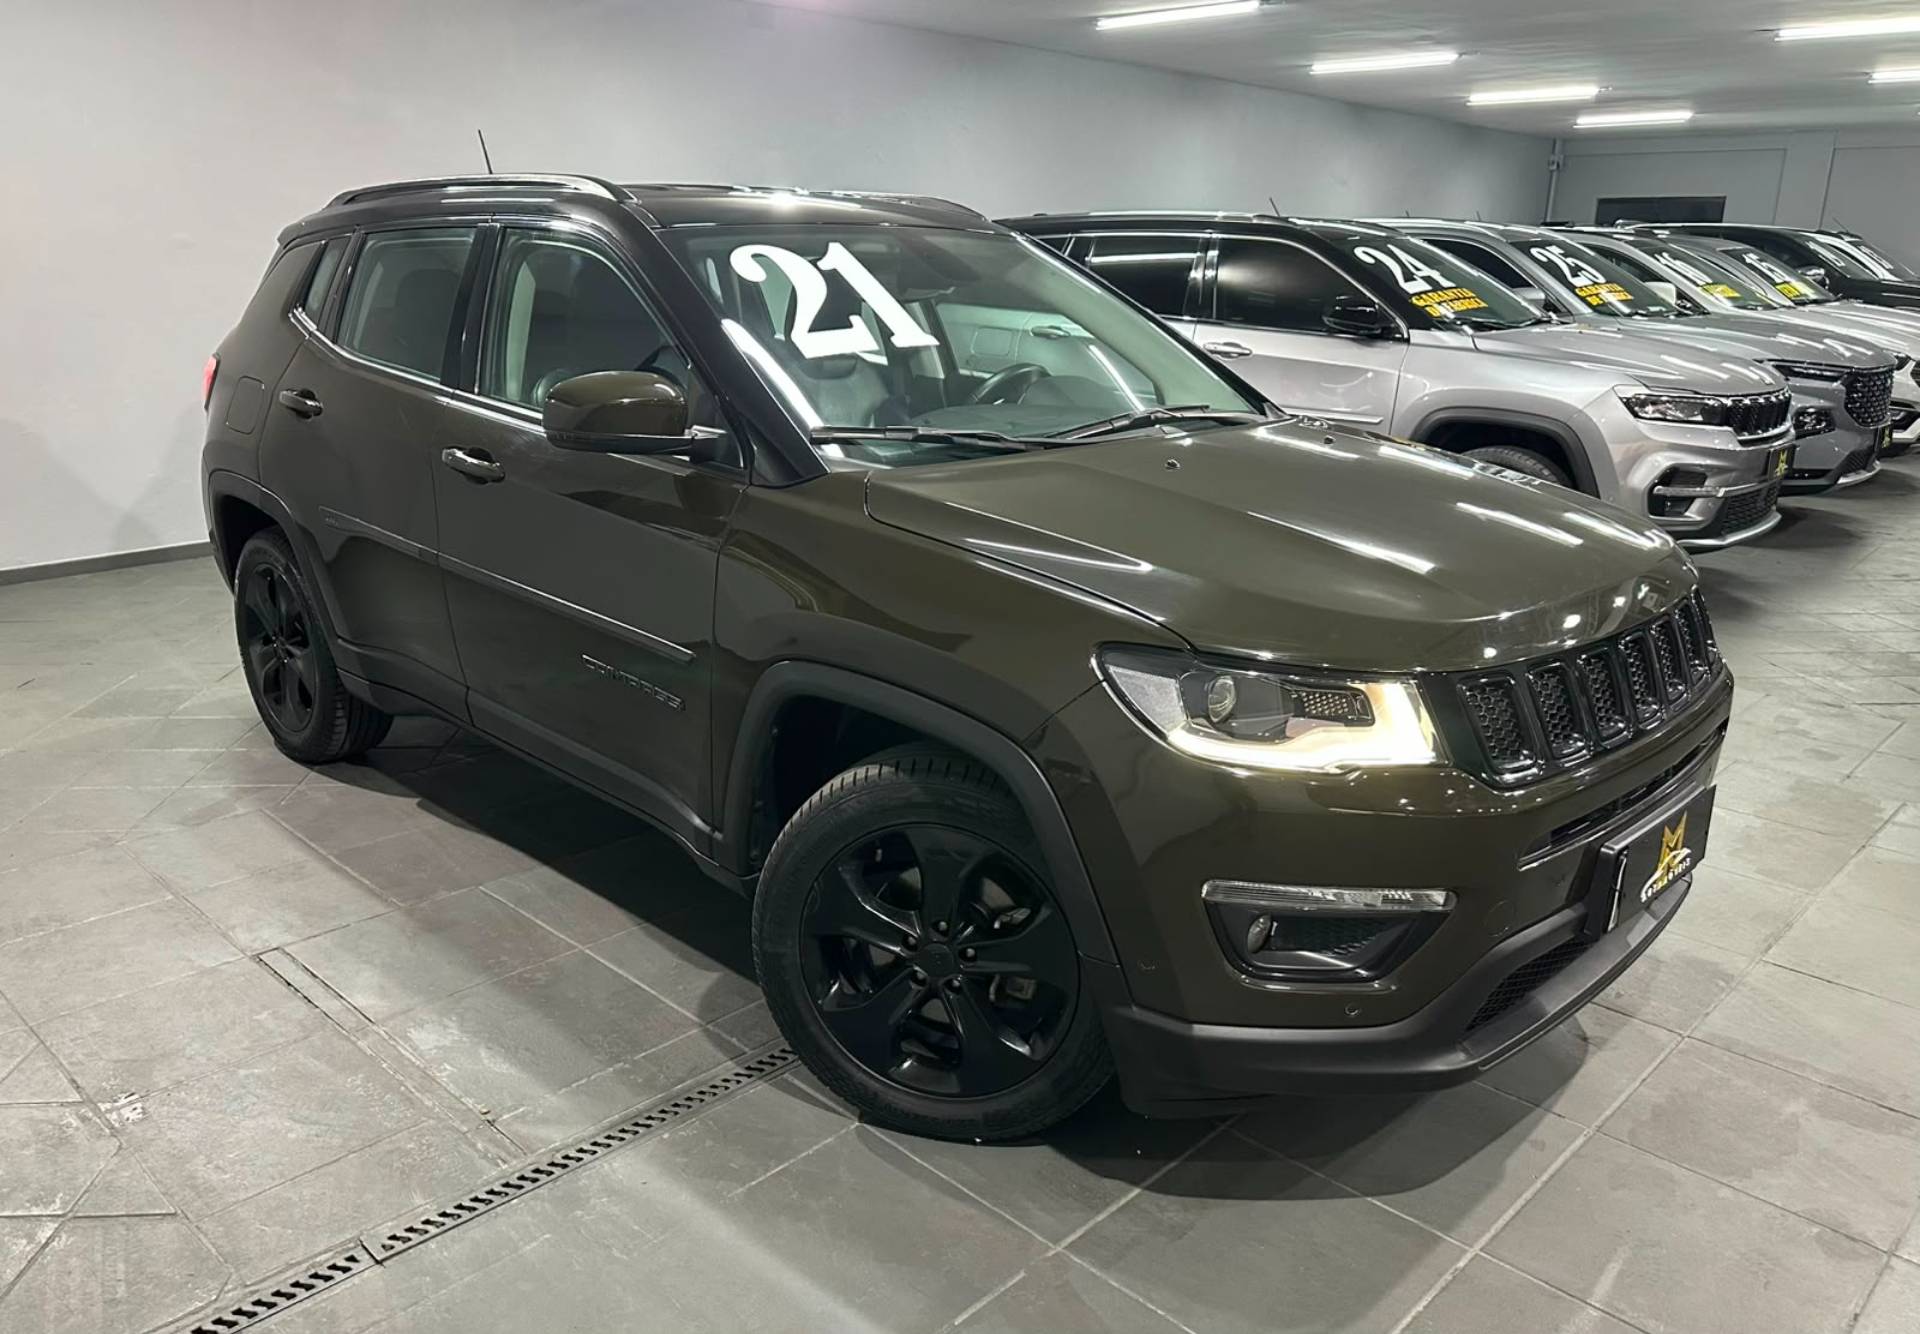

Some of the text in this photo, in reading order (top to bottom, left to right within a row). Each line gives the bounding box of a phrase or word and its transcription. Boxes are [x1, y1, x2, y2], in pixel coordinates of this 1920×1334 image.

[1353, 244, 1457, 294] 24
[1529, 245, 1607, 287] 25
[729, 241, 940, 360] 21
